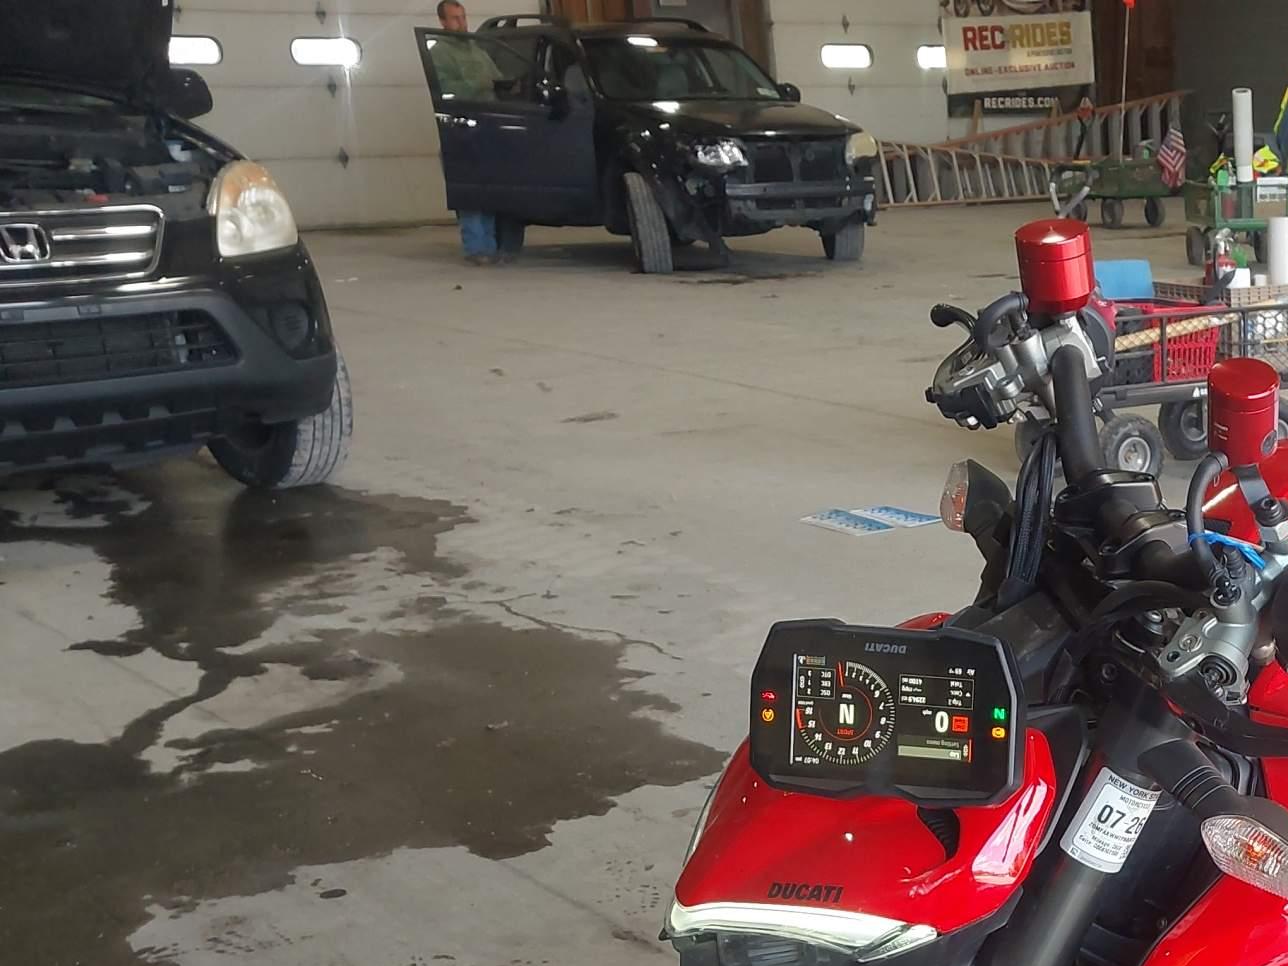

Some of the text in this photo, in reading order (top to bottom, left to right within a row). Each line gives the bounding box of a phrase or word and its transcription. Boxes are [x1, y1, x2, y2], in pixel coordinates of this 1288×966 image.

[963, 26, 1004, 51] REC
[865, 643, 906, 654] DUCATI
[839, 704, 854, 724] N
[935, 711, 949, 733] 0
[994, 708, 1004, 720] N
[1108, 774, 1128, 790] NEW
[1128, 786, 1149, 799] YORK
[1096, 804, 1147, 835] 07-26
[767, 882, 844, 904] DUCATI
